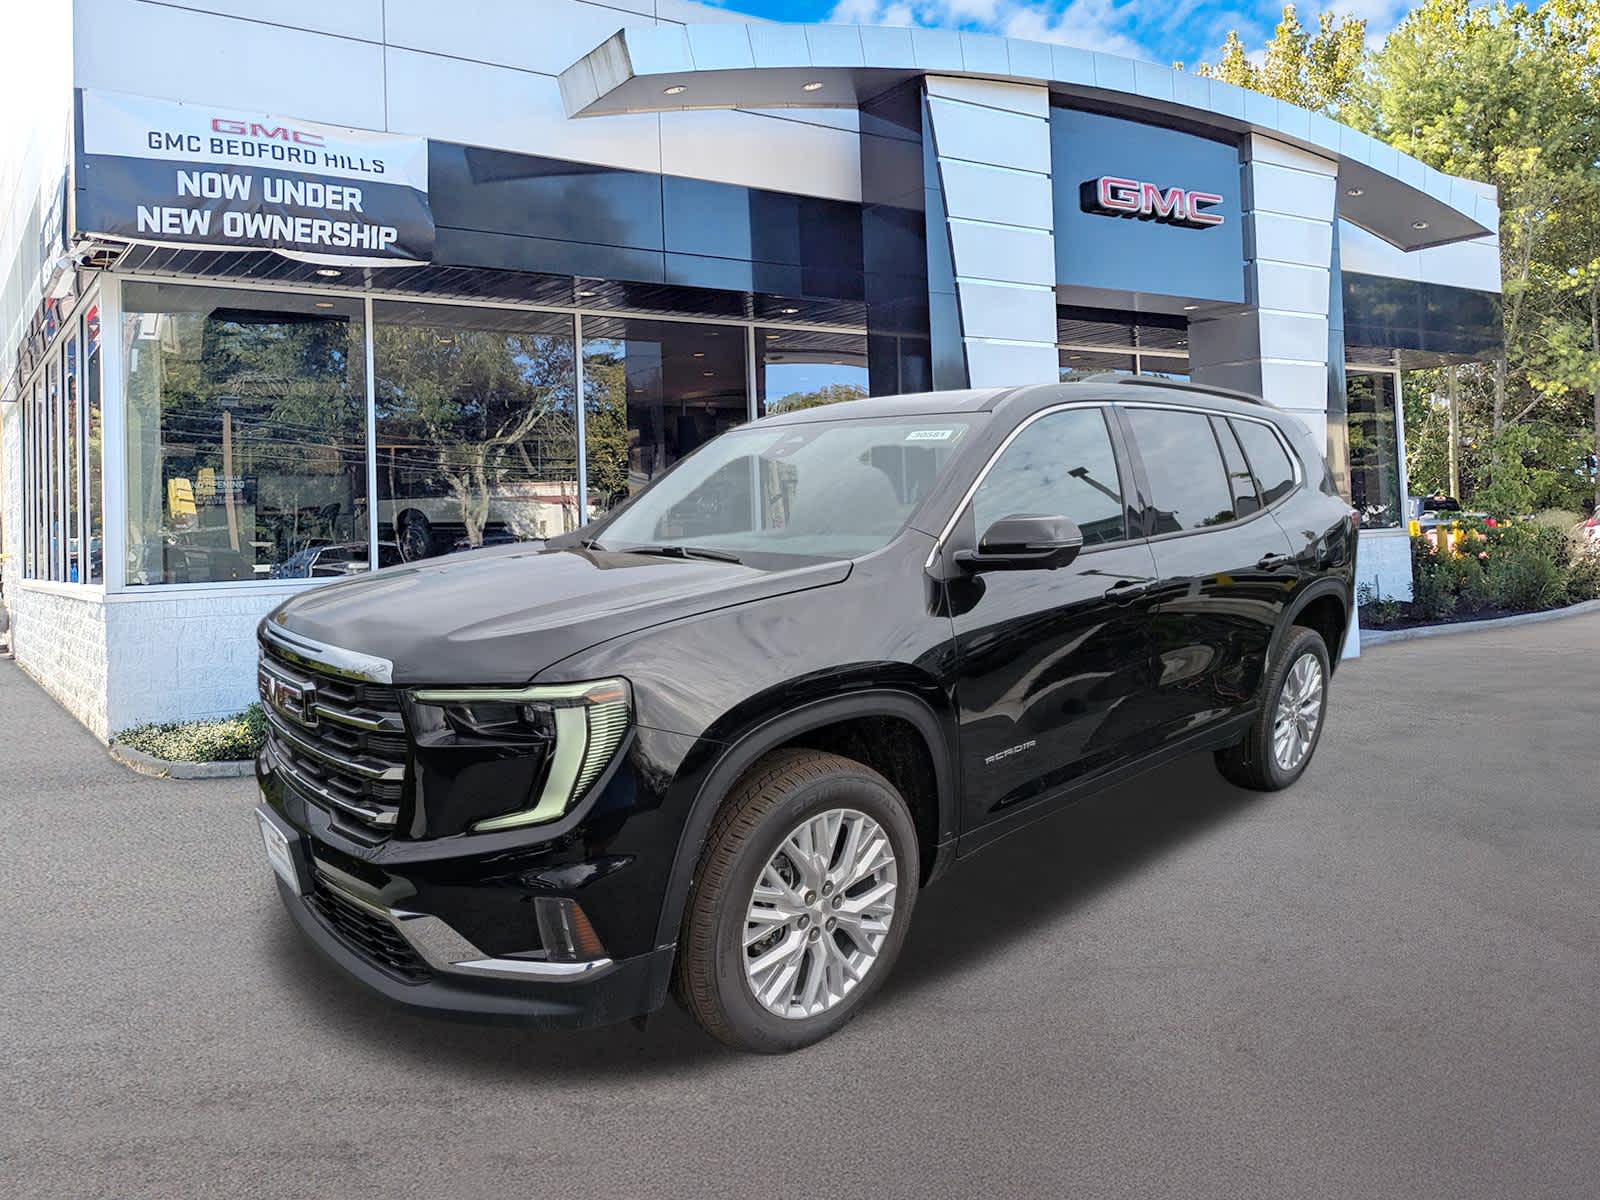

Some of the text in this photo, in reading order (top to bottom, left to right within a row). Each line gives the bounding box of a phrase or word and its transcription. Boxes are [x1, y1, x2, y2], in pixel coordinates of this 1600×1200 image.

[148, 131, 385, 174] GMC BEDFORD HILLS
[211, 118, 324, 147] GMC
[177, 170, 364, 213] NOW UNDER
[1097, 176, 1225, 224] GMC
[137, 205, 398, 250] NEW OWNERSHIP
